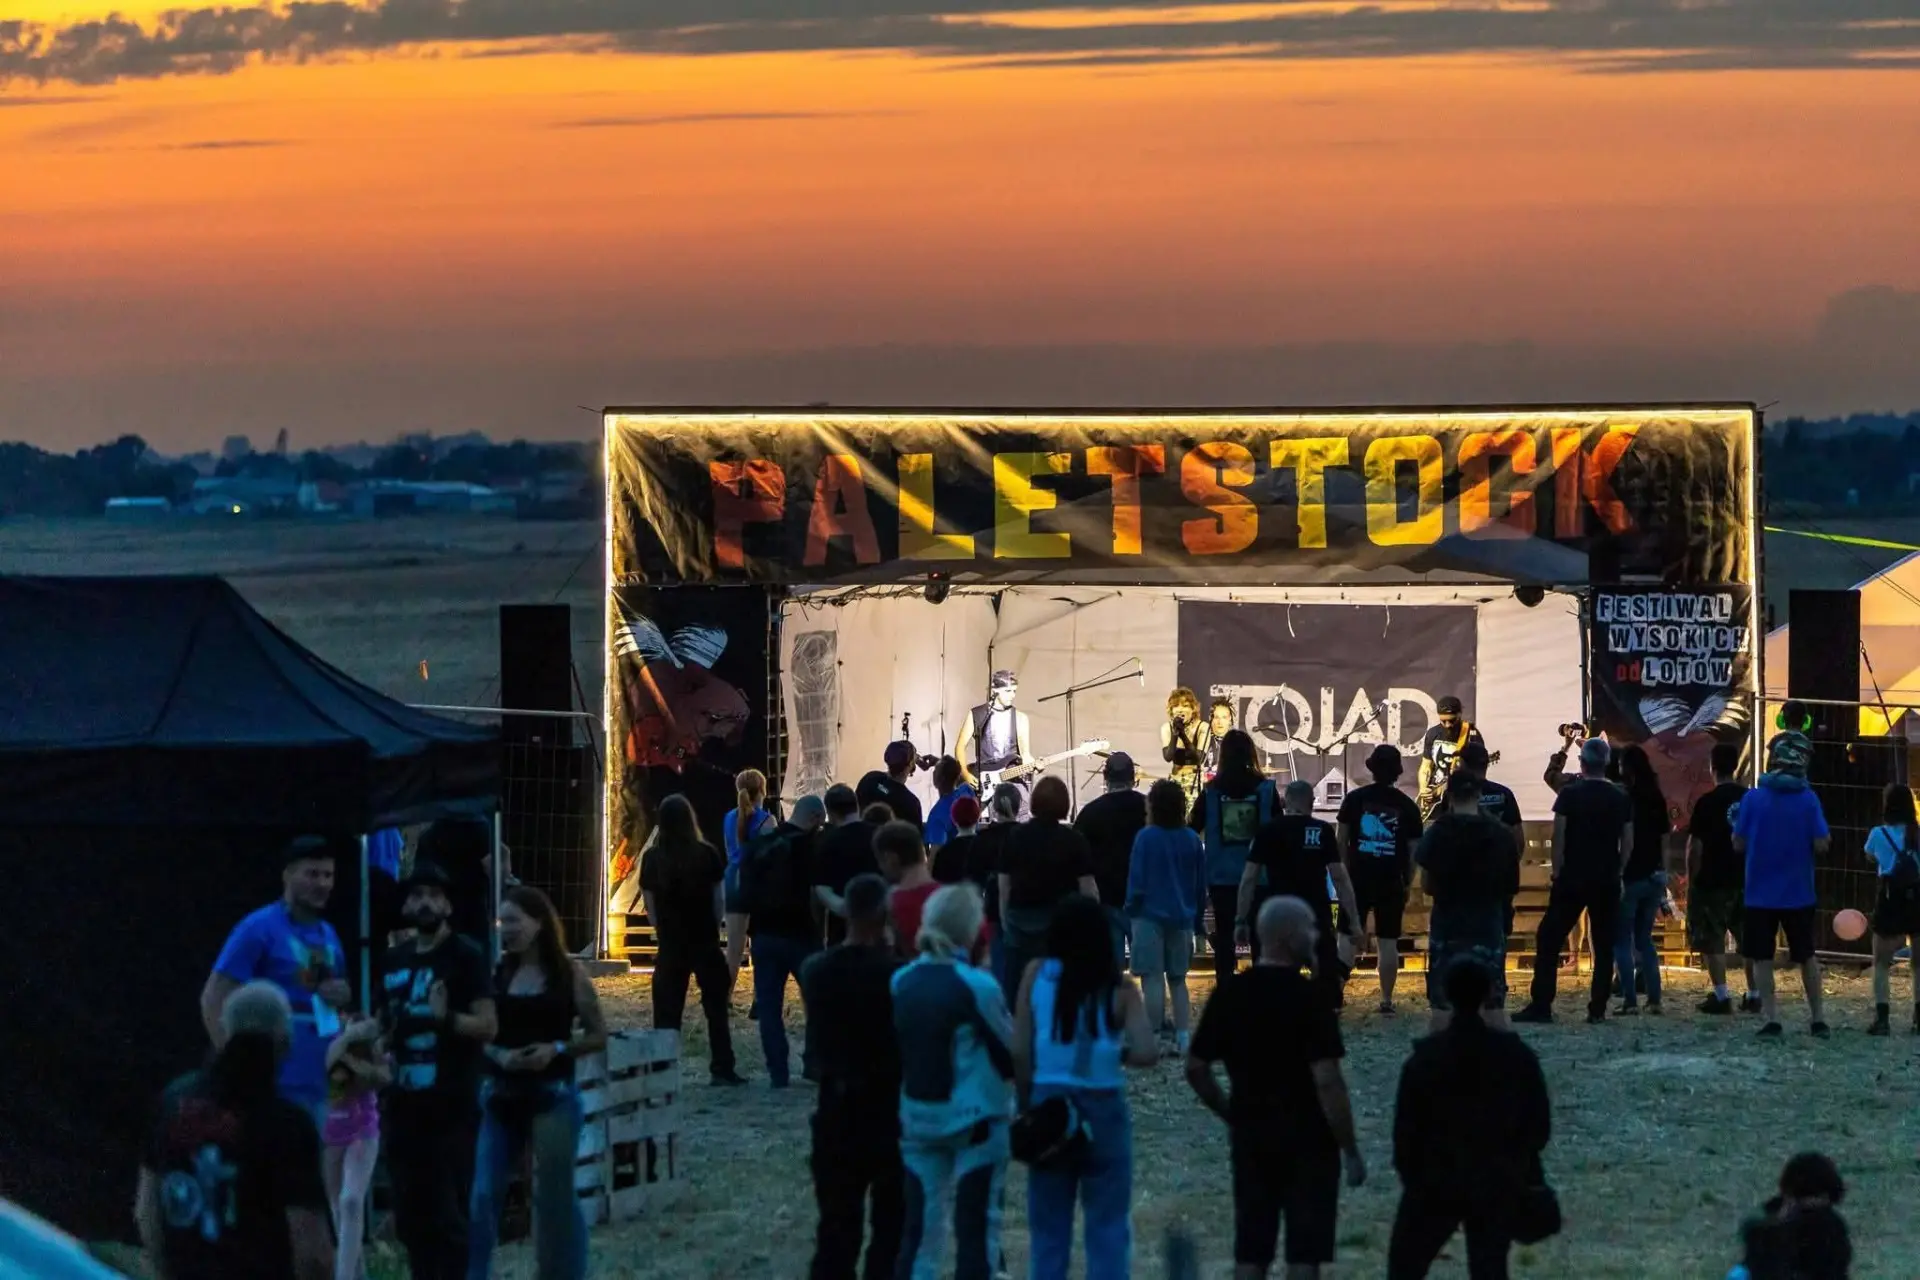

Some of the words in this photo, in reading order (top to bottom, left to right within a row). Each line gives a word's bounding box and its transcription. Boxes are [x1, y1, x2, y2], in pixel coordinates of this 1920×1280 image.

[709, 424, 1640, 568] PALETSTOCK
[1598, 593, 1732, 621] FESTIWAL
[1610, 625, 1748, 651] WYSOKICH
